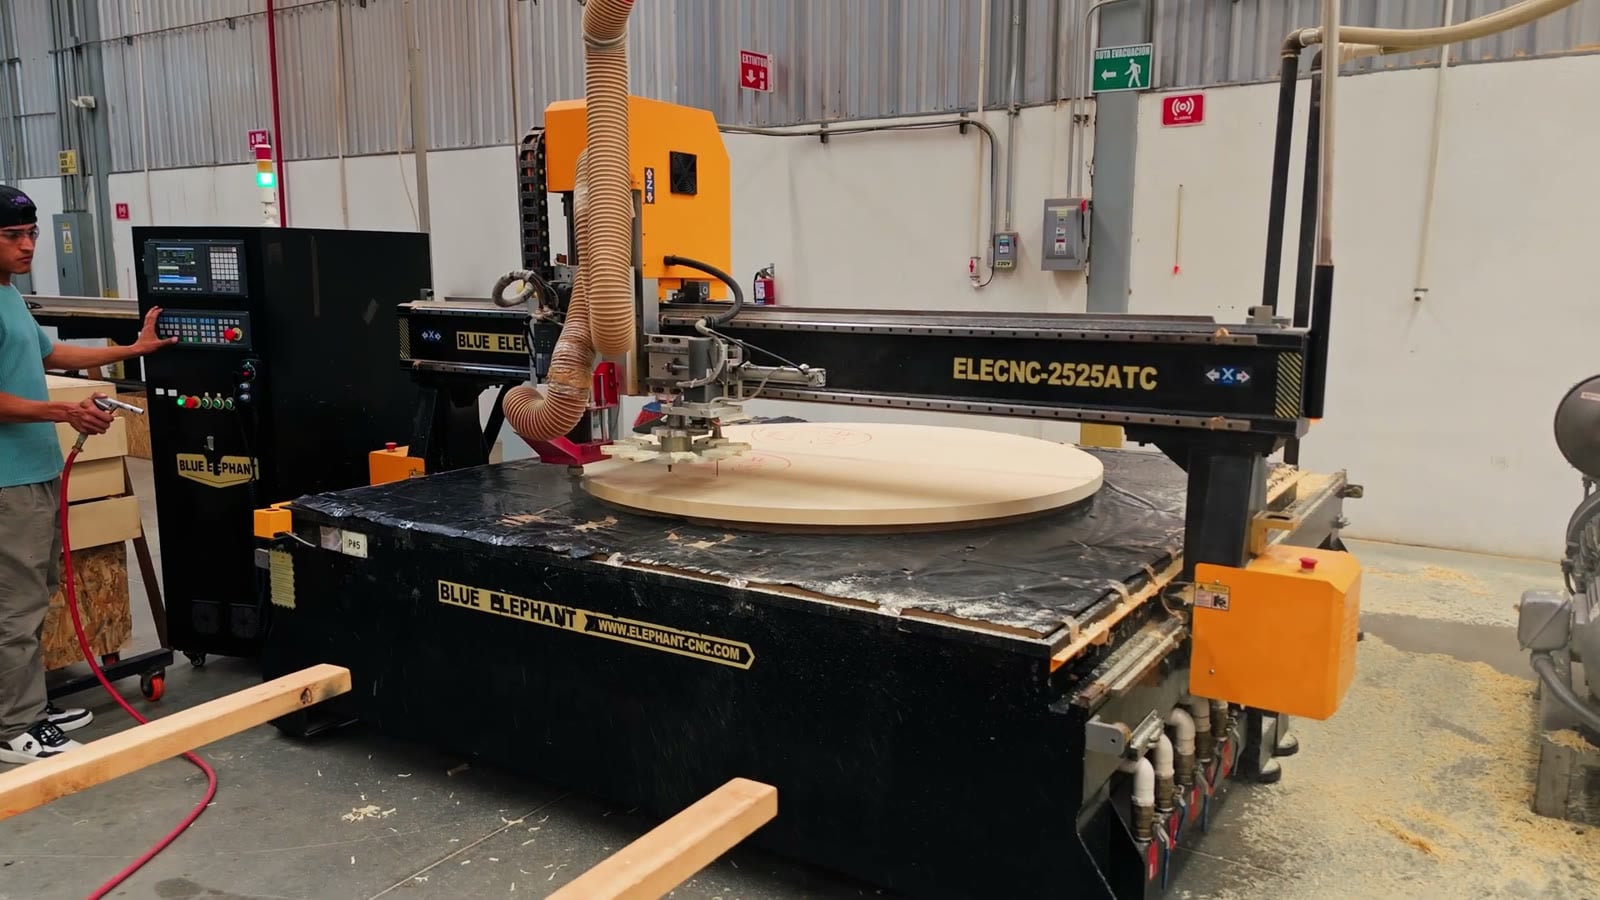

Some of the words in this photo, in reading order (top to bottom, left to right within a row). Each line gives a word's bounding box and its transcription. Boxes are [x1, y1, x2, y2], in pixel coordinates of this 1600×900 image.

[742, 53, 768, 69] EXTINTOR
[1095, 49, 1111, 60] RUTA
[646, 180, 653, 190] Z
[428, 330, 435, 339] X
[458, 333, 490, 349] BLUE
[953, 357, 1158, 390] ELECNC-2525ATC
[1222, 367, 1235, 380] X
[179, 459, 205, 473] BLUE
[207, 462, 257, 476] EEPHANT
[439, 583, 480, 607] BLUE
[490, 593, 577, 628] ELEPHANT
[598, 619, 740, 661] WWW.ELEPHANT-CNC.COM
